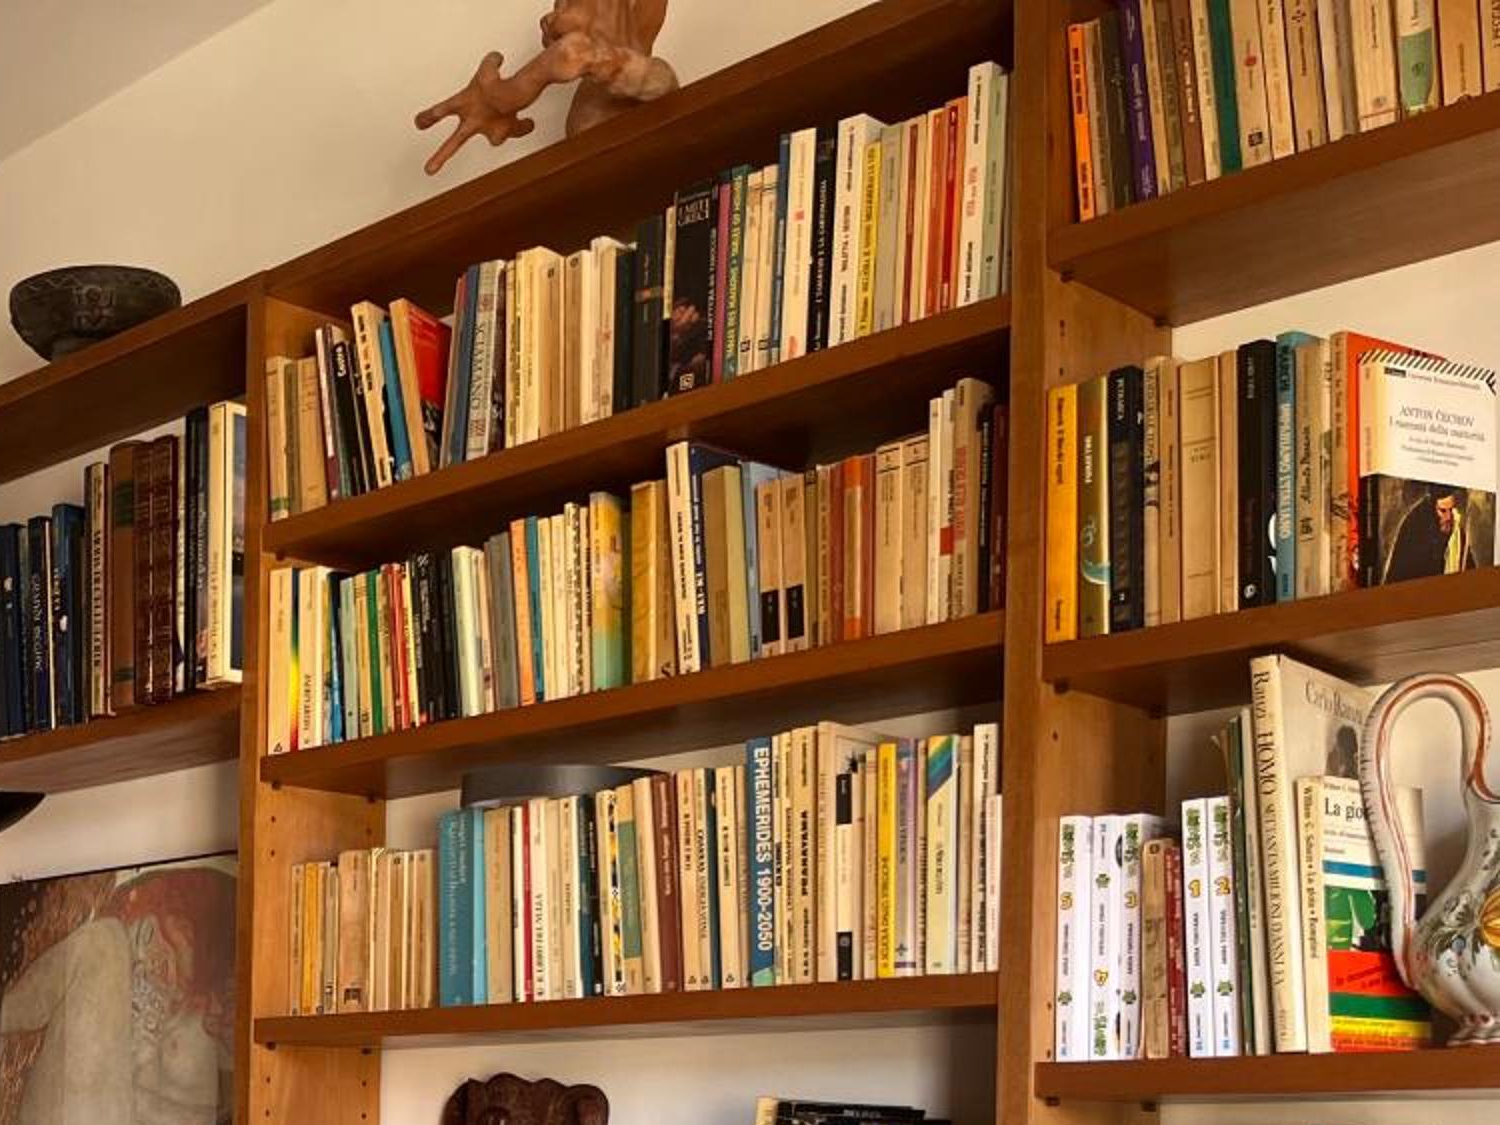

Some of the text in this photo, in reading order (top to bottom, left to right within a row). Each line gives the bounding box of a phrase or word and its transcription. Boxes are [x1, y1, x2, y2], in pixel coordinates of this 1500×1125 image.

[1398, 406, 1434, 421] ANTON
[1255, 730, 1276, 796] HOMO
[1324, 796, 1342, 817] La
[754, 746, 774, 951] EPHEMERIDES 1900-2050
